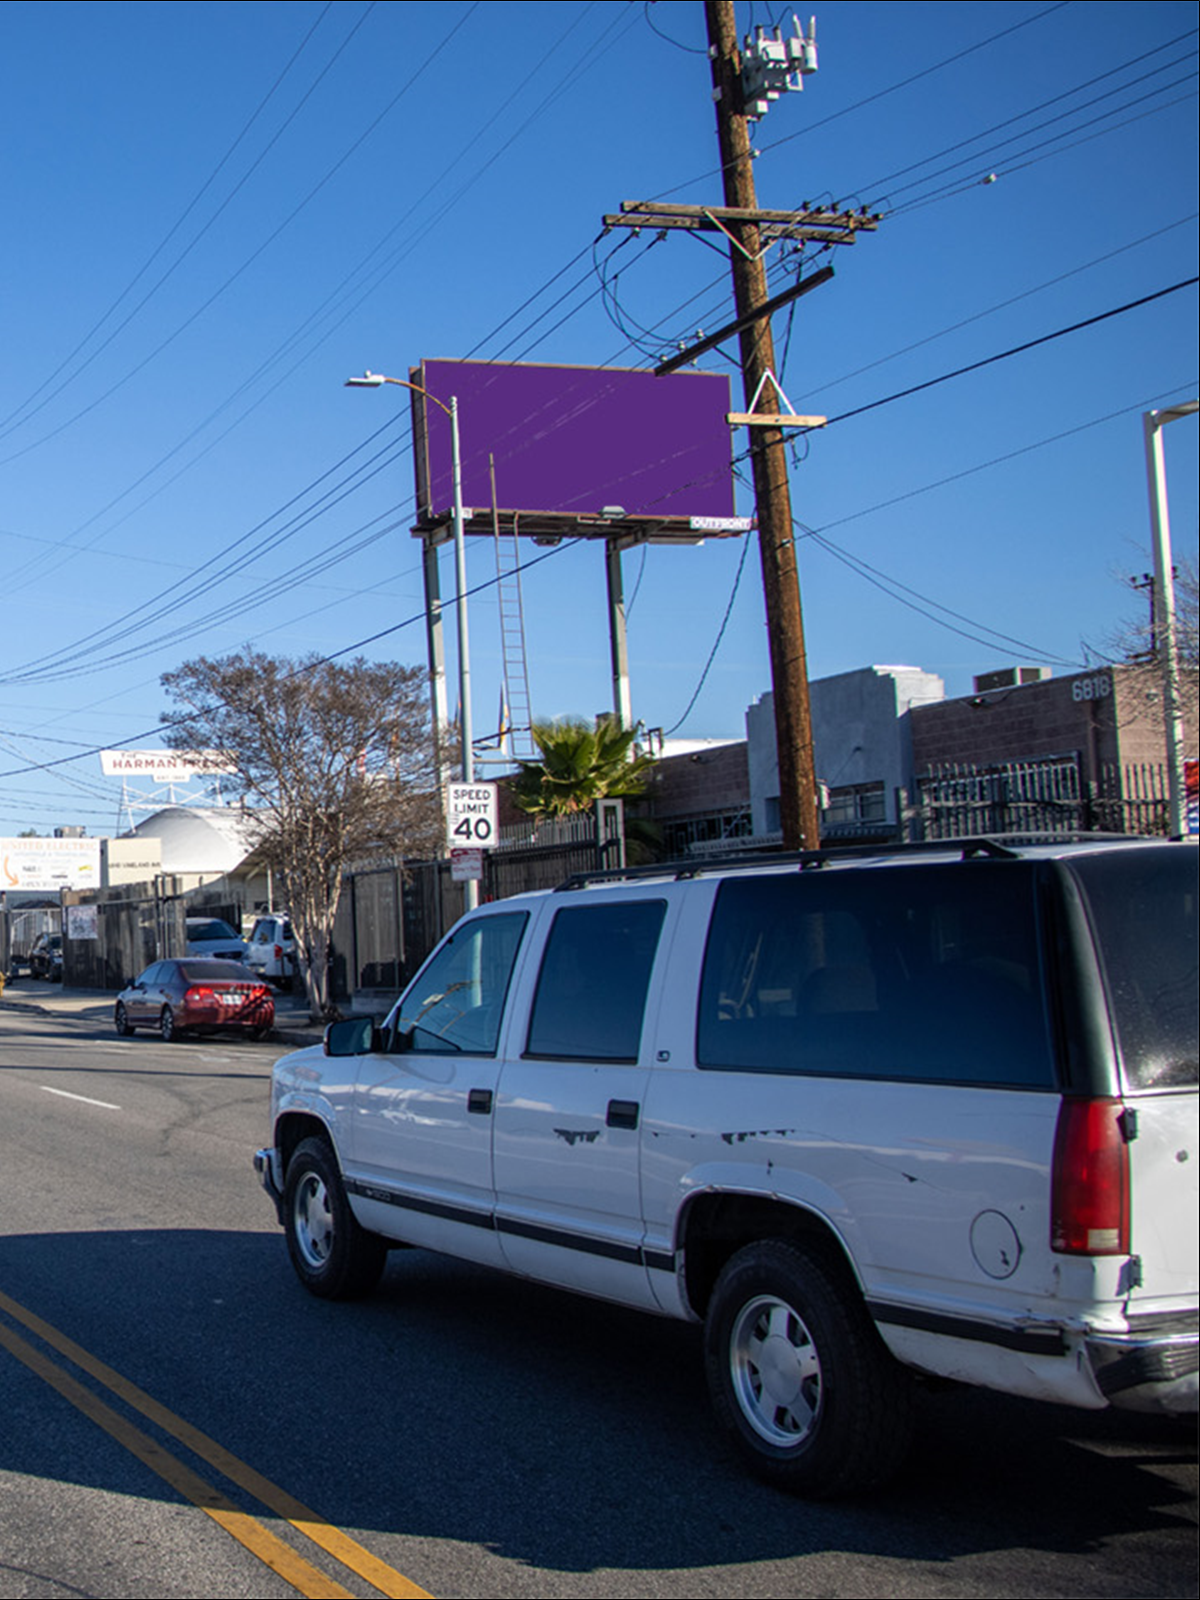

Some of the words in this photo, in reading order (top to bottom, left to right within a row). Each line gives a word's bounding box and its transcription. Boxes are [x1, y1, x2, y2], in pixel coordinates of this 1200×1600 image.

[1072, 676, 1110, 701] 6818
[112, 759, 177, 769] HARMAN
[453, 789, 491, 800] SPEED
[454, 803, 489, 814] LIMIT
[453, 817, 492, 840] 40
